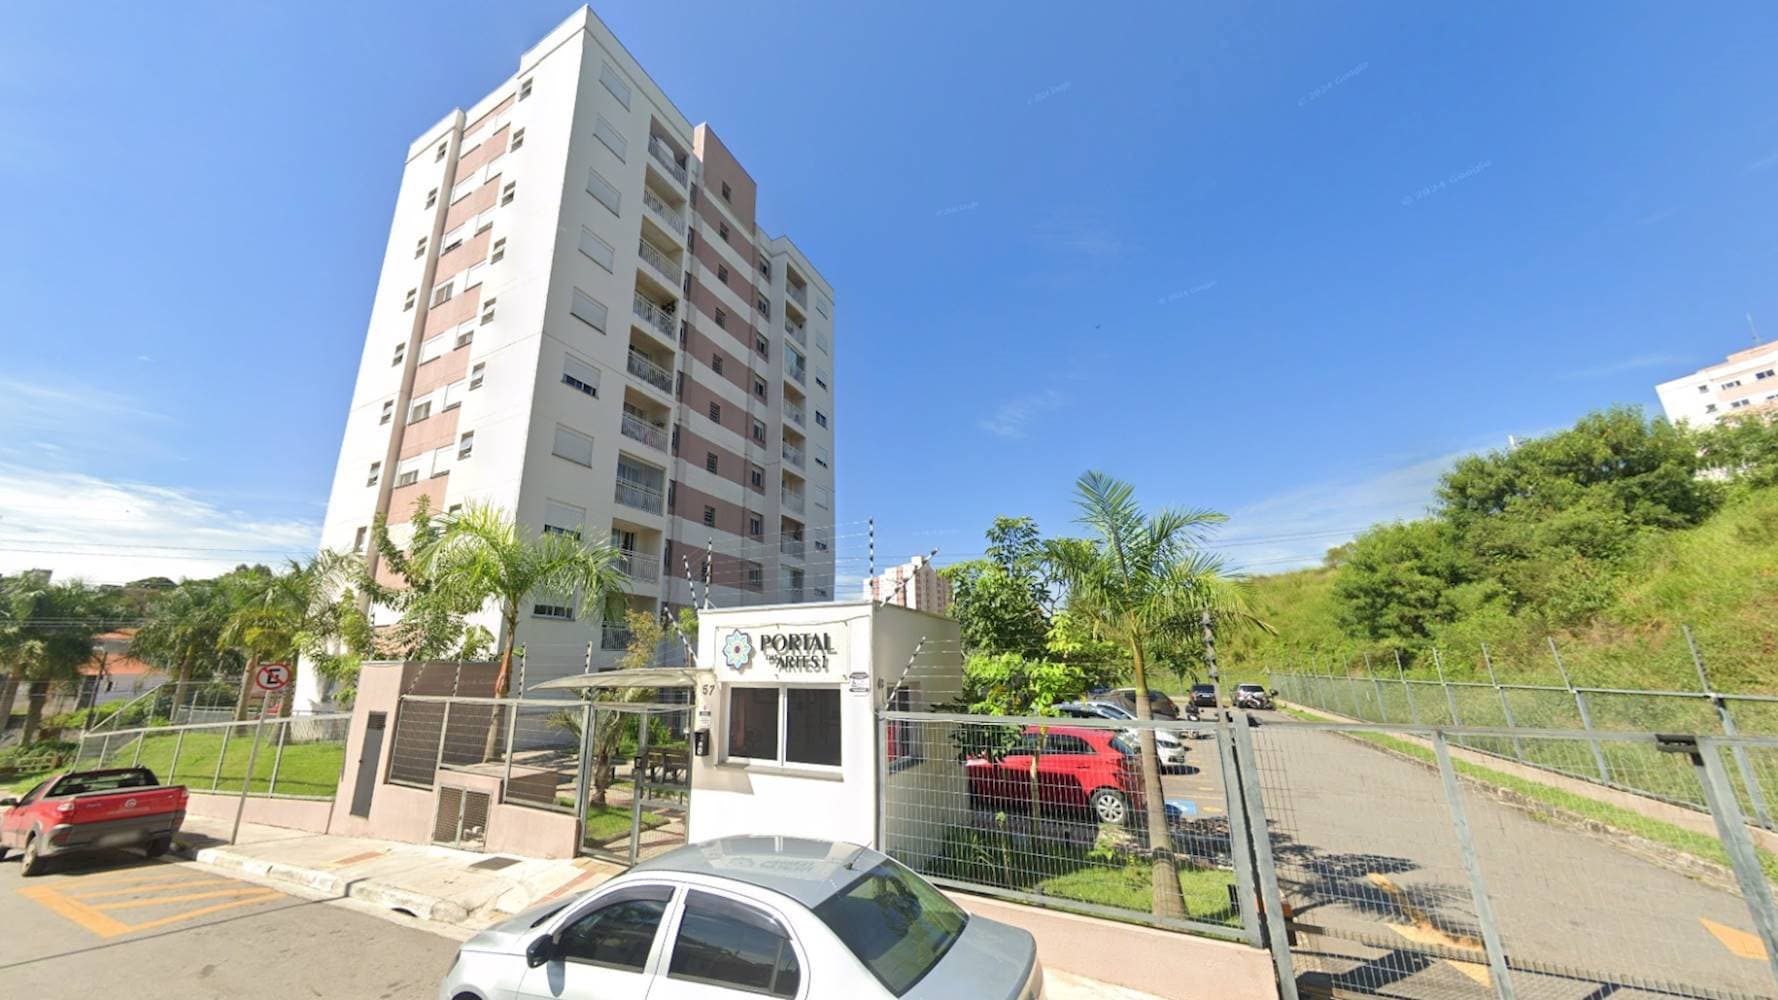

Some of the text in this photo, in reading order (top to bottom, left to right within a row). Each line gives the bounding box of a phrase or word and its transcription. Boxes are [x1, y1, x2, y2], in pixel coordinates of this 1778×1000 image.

[761, 632, 835, 652] PORTAL
[776, 655, 819, 669] ARTES
[702, 684, 715, 696] 57
